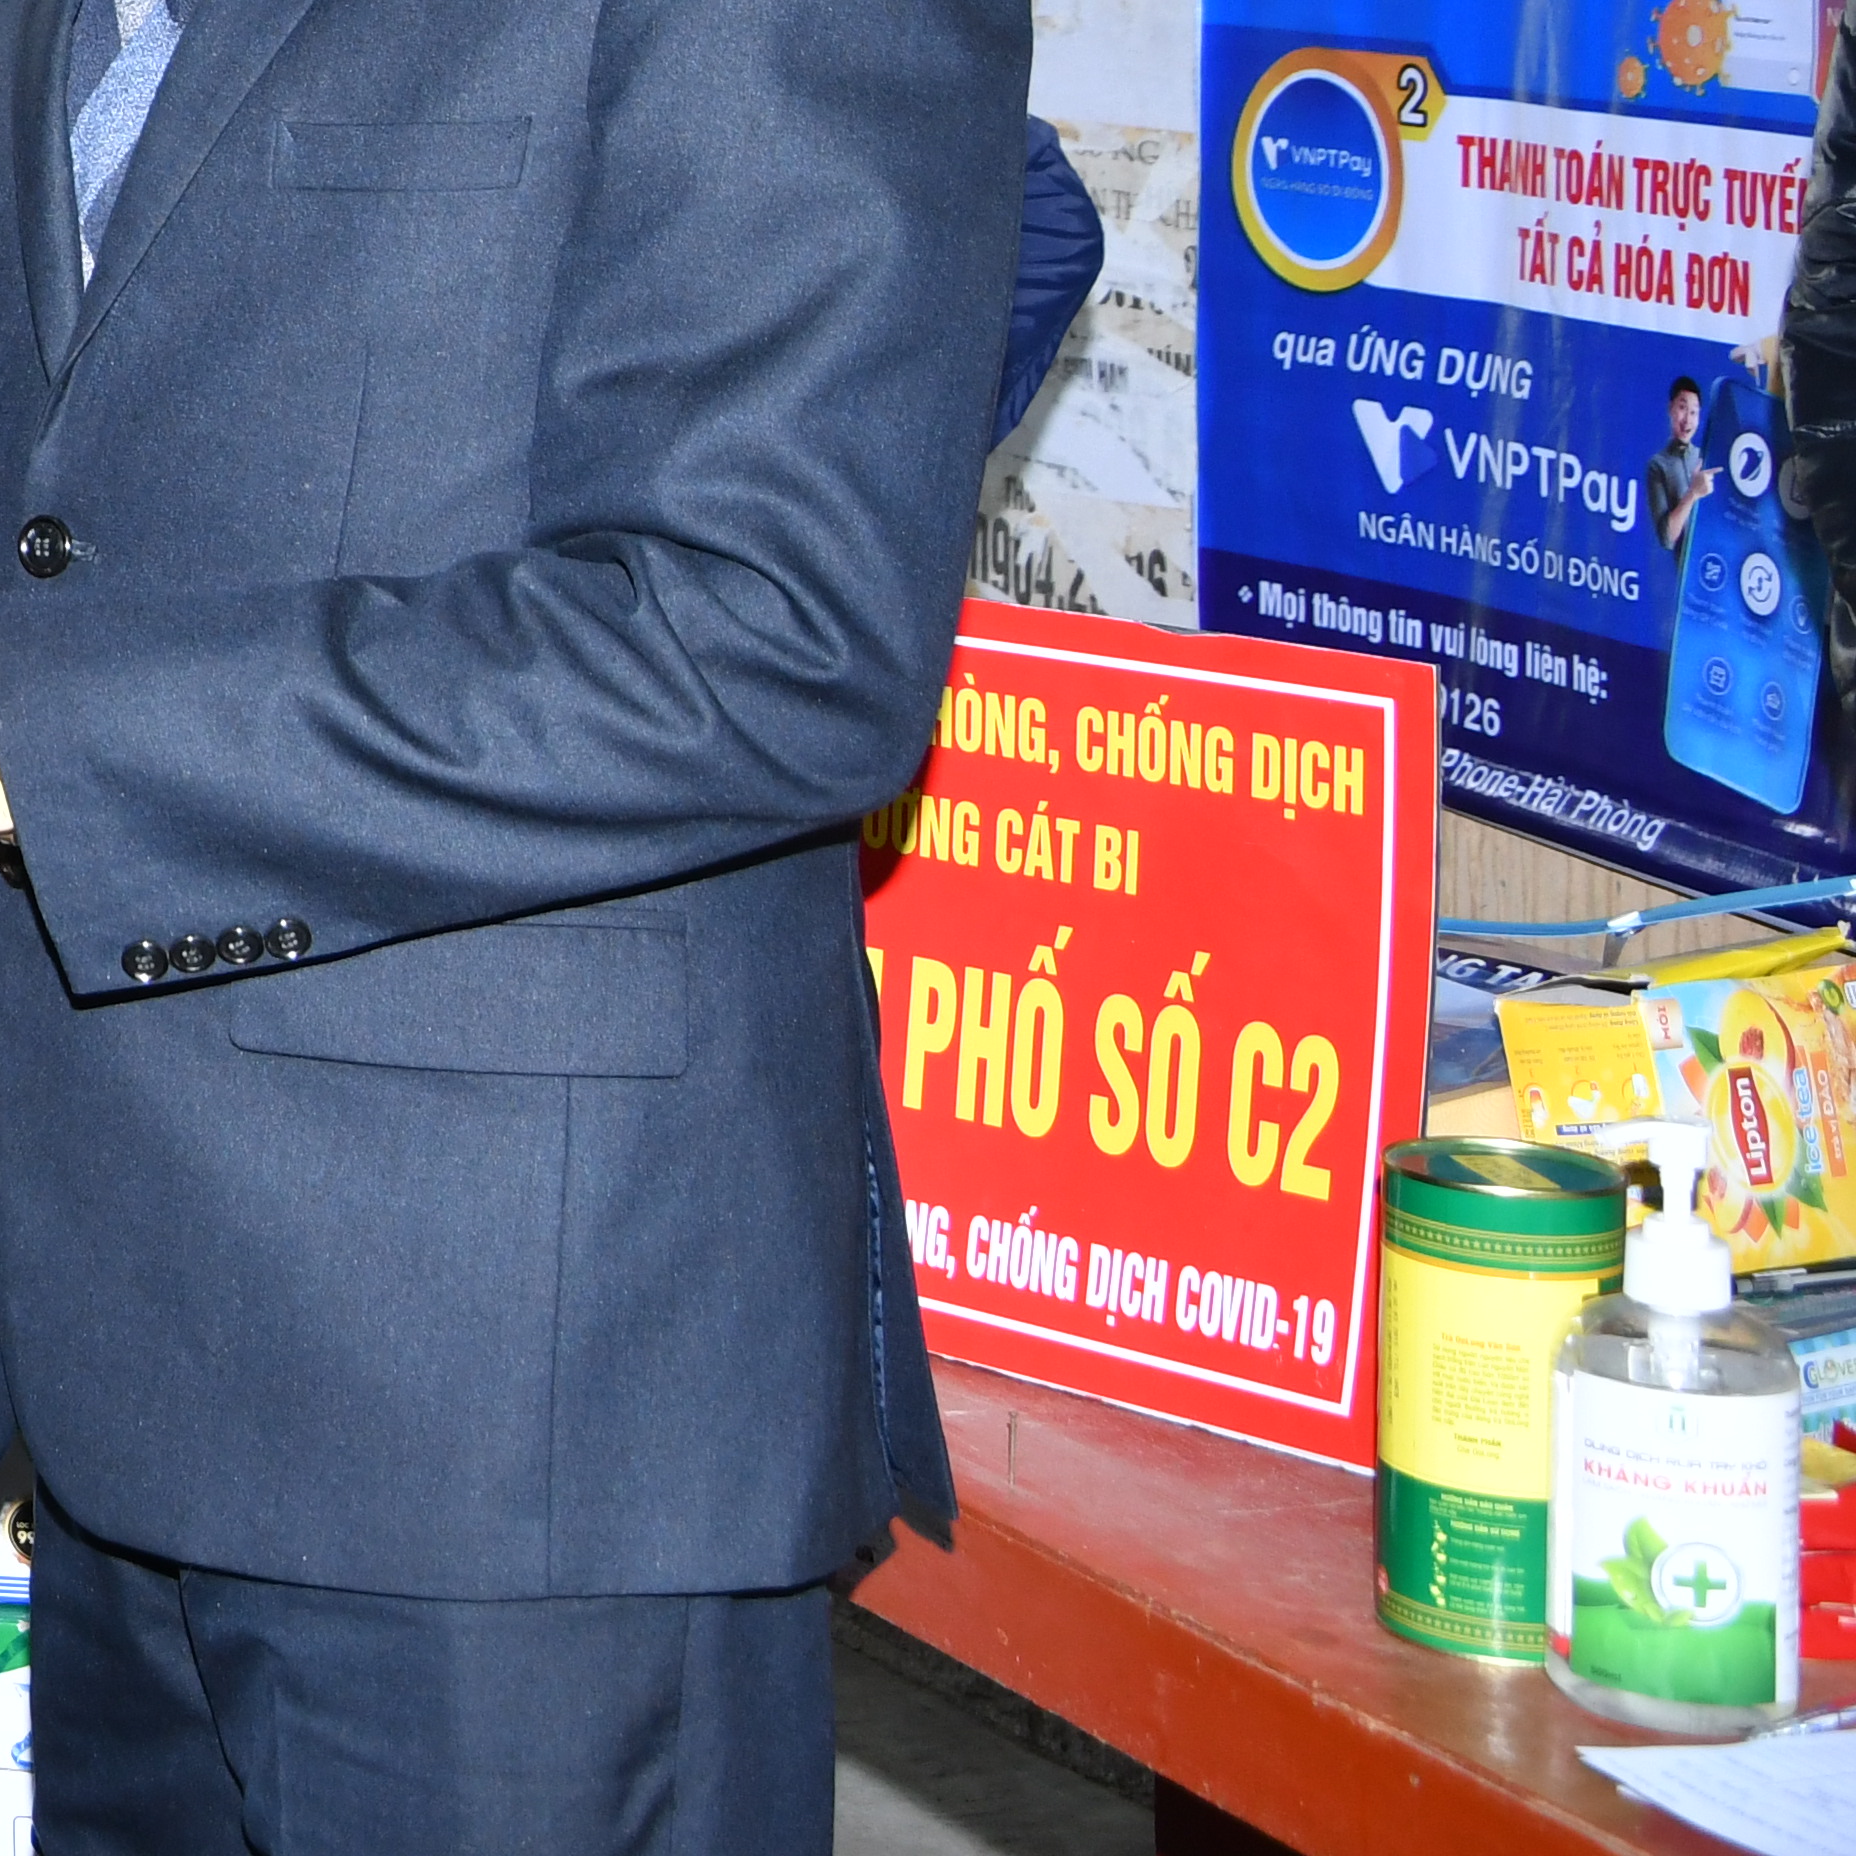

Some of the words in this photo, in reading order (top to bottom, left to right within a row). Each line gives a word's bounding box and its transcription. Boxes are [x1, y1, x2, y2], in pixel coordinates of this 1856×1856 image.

[1396, 64, 1430, 127] 2
[1457, 135, 1548, 199] THANH
[1553, 139, 1625, 212] TOÁN
[1633, 156, 1712, 232] TRỰC
[1517, 211, 1561, 286] TẤT
[1566, 220, 1605, 295] CẢ
[1614, 233, 1675, 307] HÓA
[1684, 255, 1751, 317] ĐƠN
[1273, 330, 1335, 375] qua
[1345, 324, 1427, 380] ỨNG
[1437, 348, 1534, 401] DỤNG
[1444, 427, 1639, 534] VNPTPay
[1358, 511, 1436, 549] NGÂN
[1440, 522, 1502, 569] HÀNG
[1506, 538, 1540, 576] SỐ
[1543, 550, 1565, 584] DI
[1568, 556, 1640, 602] ĐỘNG
[1257, 580, 1308, 631] Mọi
[1311, 591, 1382, 644] thông
[1388, 609, 1423, 649] tin
[1430, 619, 1466, 659] vui
[1469, 627, 1520, 679] lòng
[1524, 636, 1568, 688] liên
[1572, 653, 1609, 706] hệ:
[1075, 694, 1235, 796] CHỐNG
[1250, 730, 1365, 821] DỊCH
[994, 800, 1081, 884] CÁT
[1092, 823, 1141, 896] BI
[1571, 784, 1667, 851] Phòng
[902, 926, 1074, 1139] PHỐ
[1088, 951, 1212, 1168] SỐ
[1226, 1020, 1341, 1202] C2
[1792, 1066, 1813, 1119] tea
[1736, 1076, 1768, 1178] Lipton
[1803, 1124, 1823, 1174] ice
[965, 1206, 1080, 1303] CHỐNG
[1085, 1242, 1168, 1327] DỊCH
[1175, 1265, 1337, 1366] COVID-19
[1583, 1455, 1673, 1491] KHÁNG
[1683, 1469, 1768, 1497] KHUẨN
